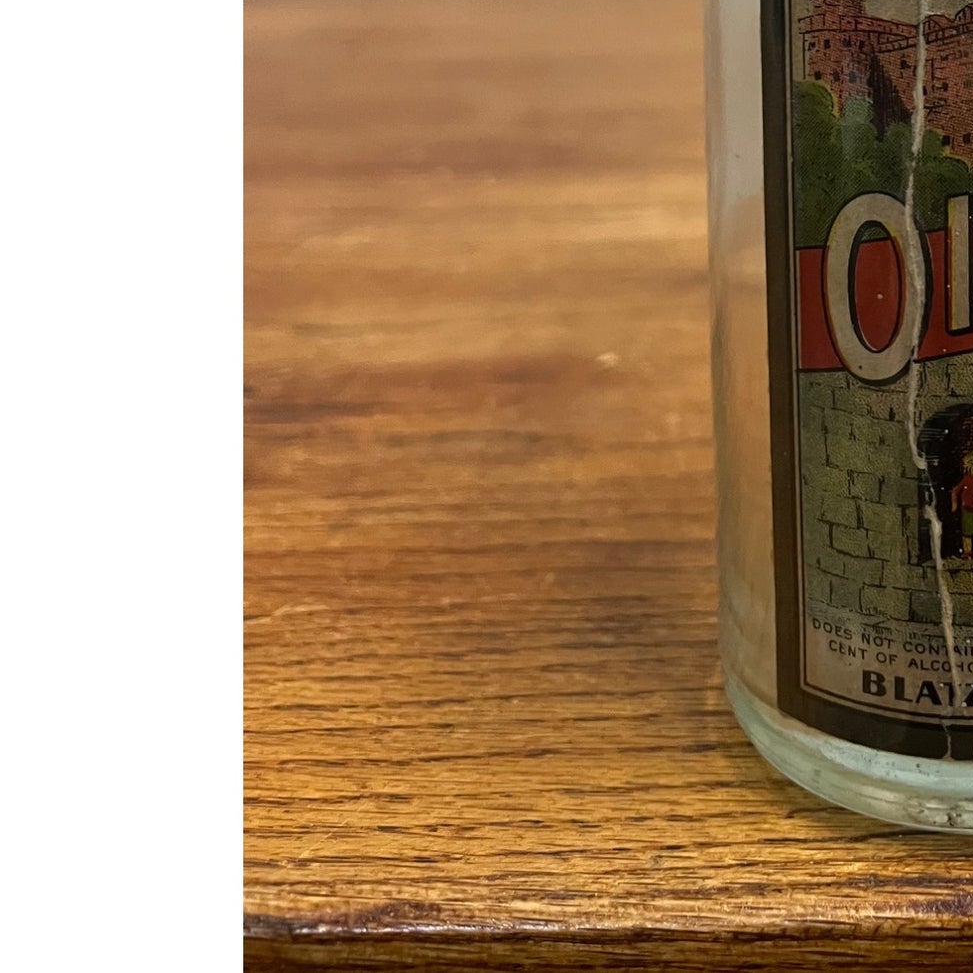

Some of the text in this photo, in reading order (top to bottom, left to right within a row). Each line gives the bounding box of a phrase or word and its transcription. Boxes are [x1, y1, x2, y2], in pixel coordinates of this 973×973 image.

[812, 617, 853, 640] DOES
[861, 633, 895, 649] NOT
[829, 639, 868, 661] CENT
[876, 652, 899, 666] OF
